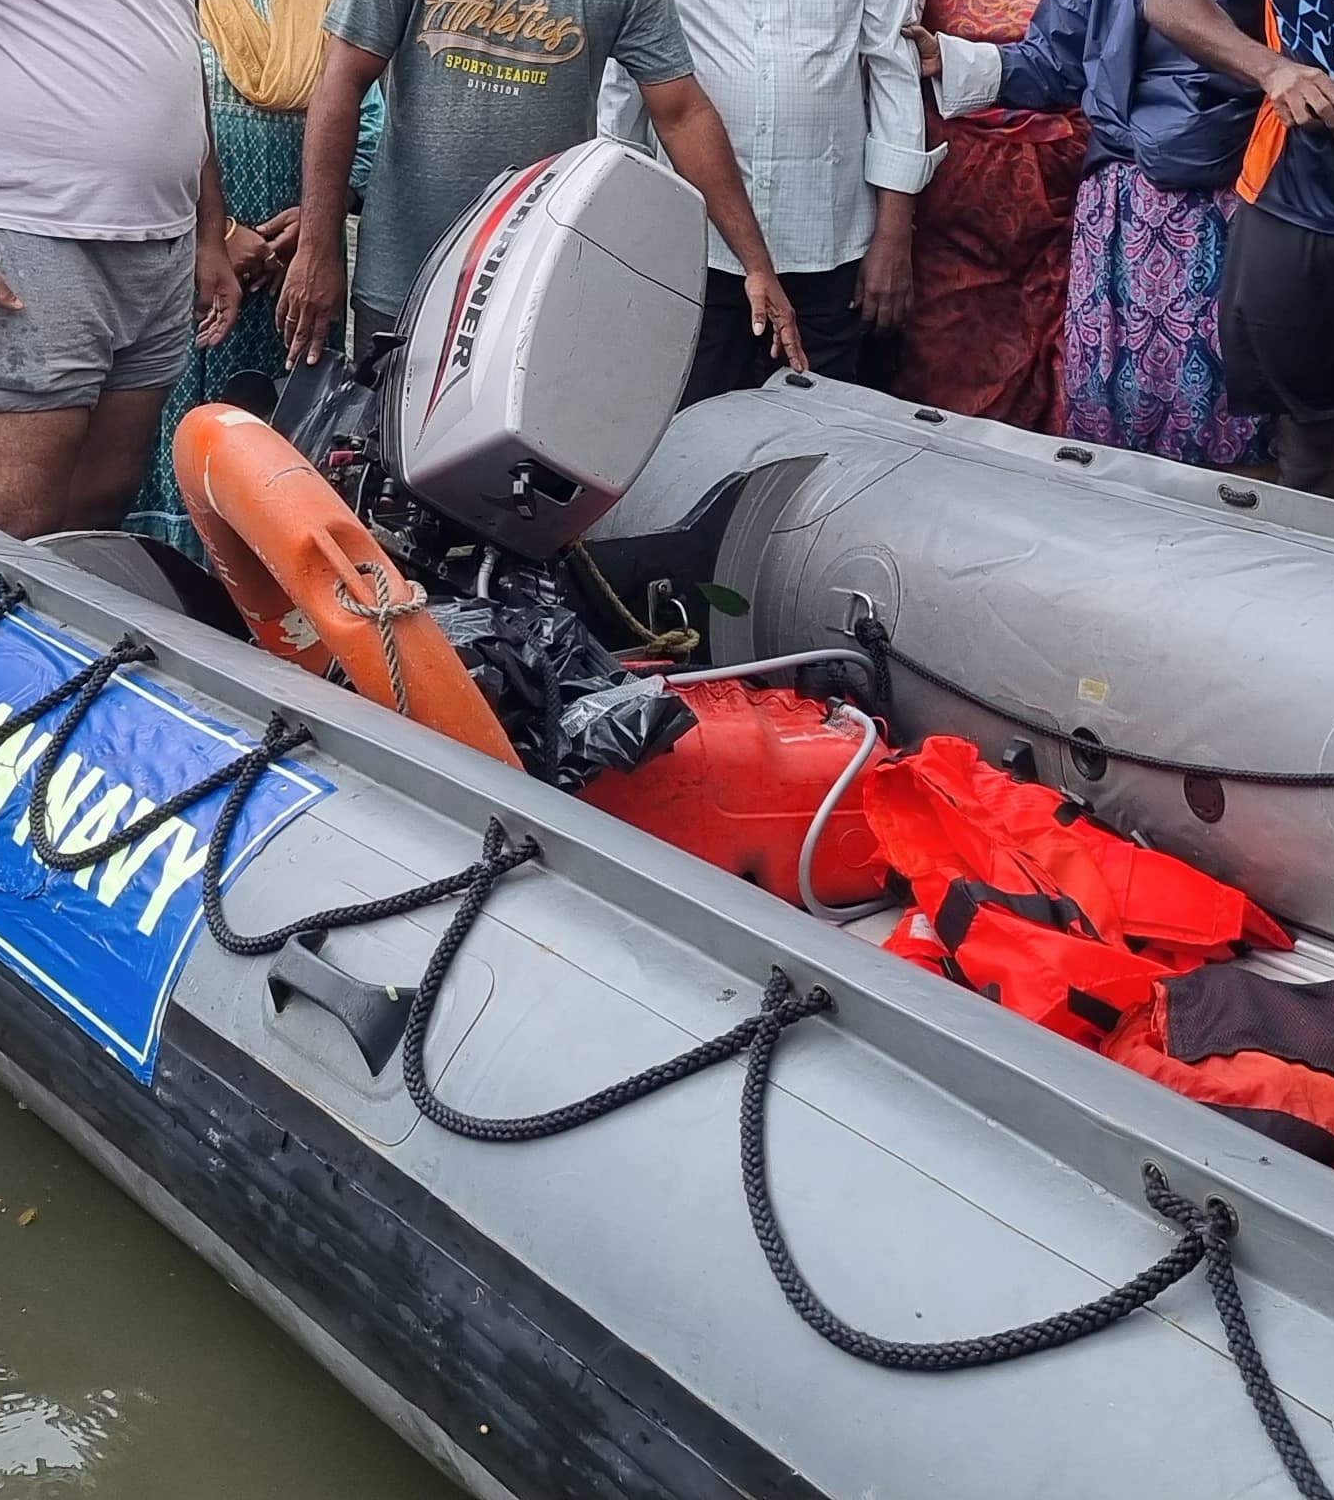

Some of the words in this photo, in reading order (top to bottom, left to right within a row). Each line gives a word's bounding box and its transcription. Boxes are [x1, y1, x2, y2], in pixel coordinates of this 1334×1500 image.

[445, 54, 493, 77] SPORTS
[497, 66, 548, 85] LEAGUE
[468, 80, 520, 96] DIVISION
[452, 170, 559, 368] MARINER
[14, 753, 209, 936] NAVY
